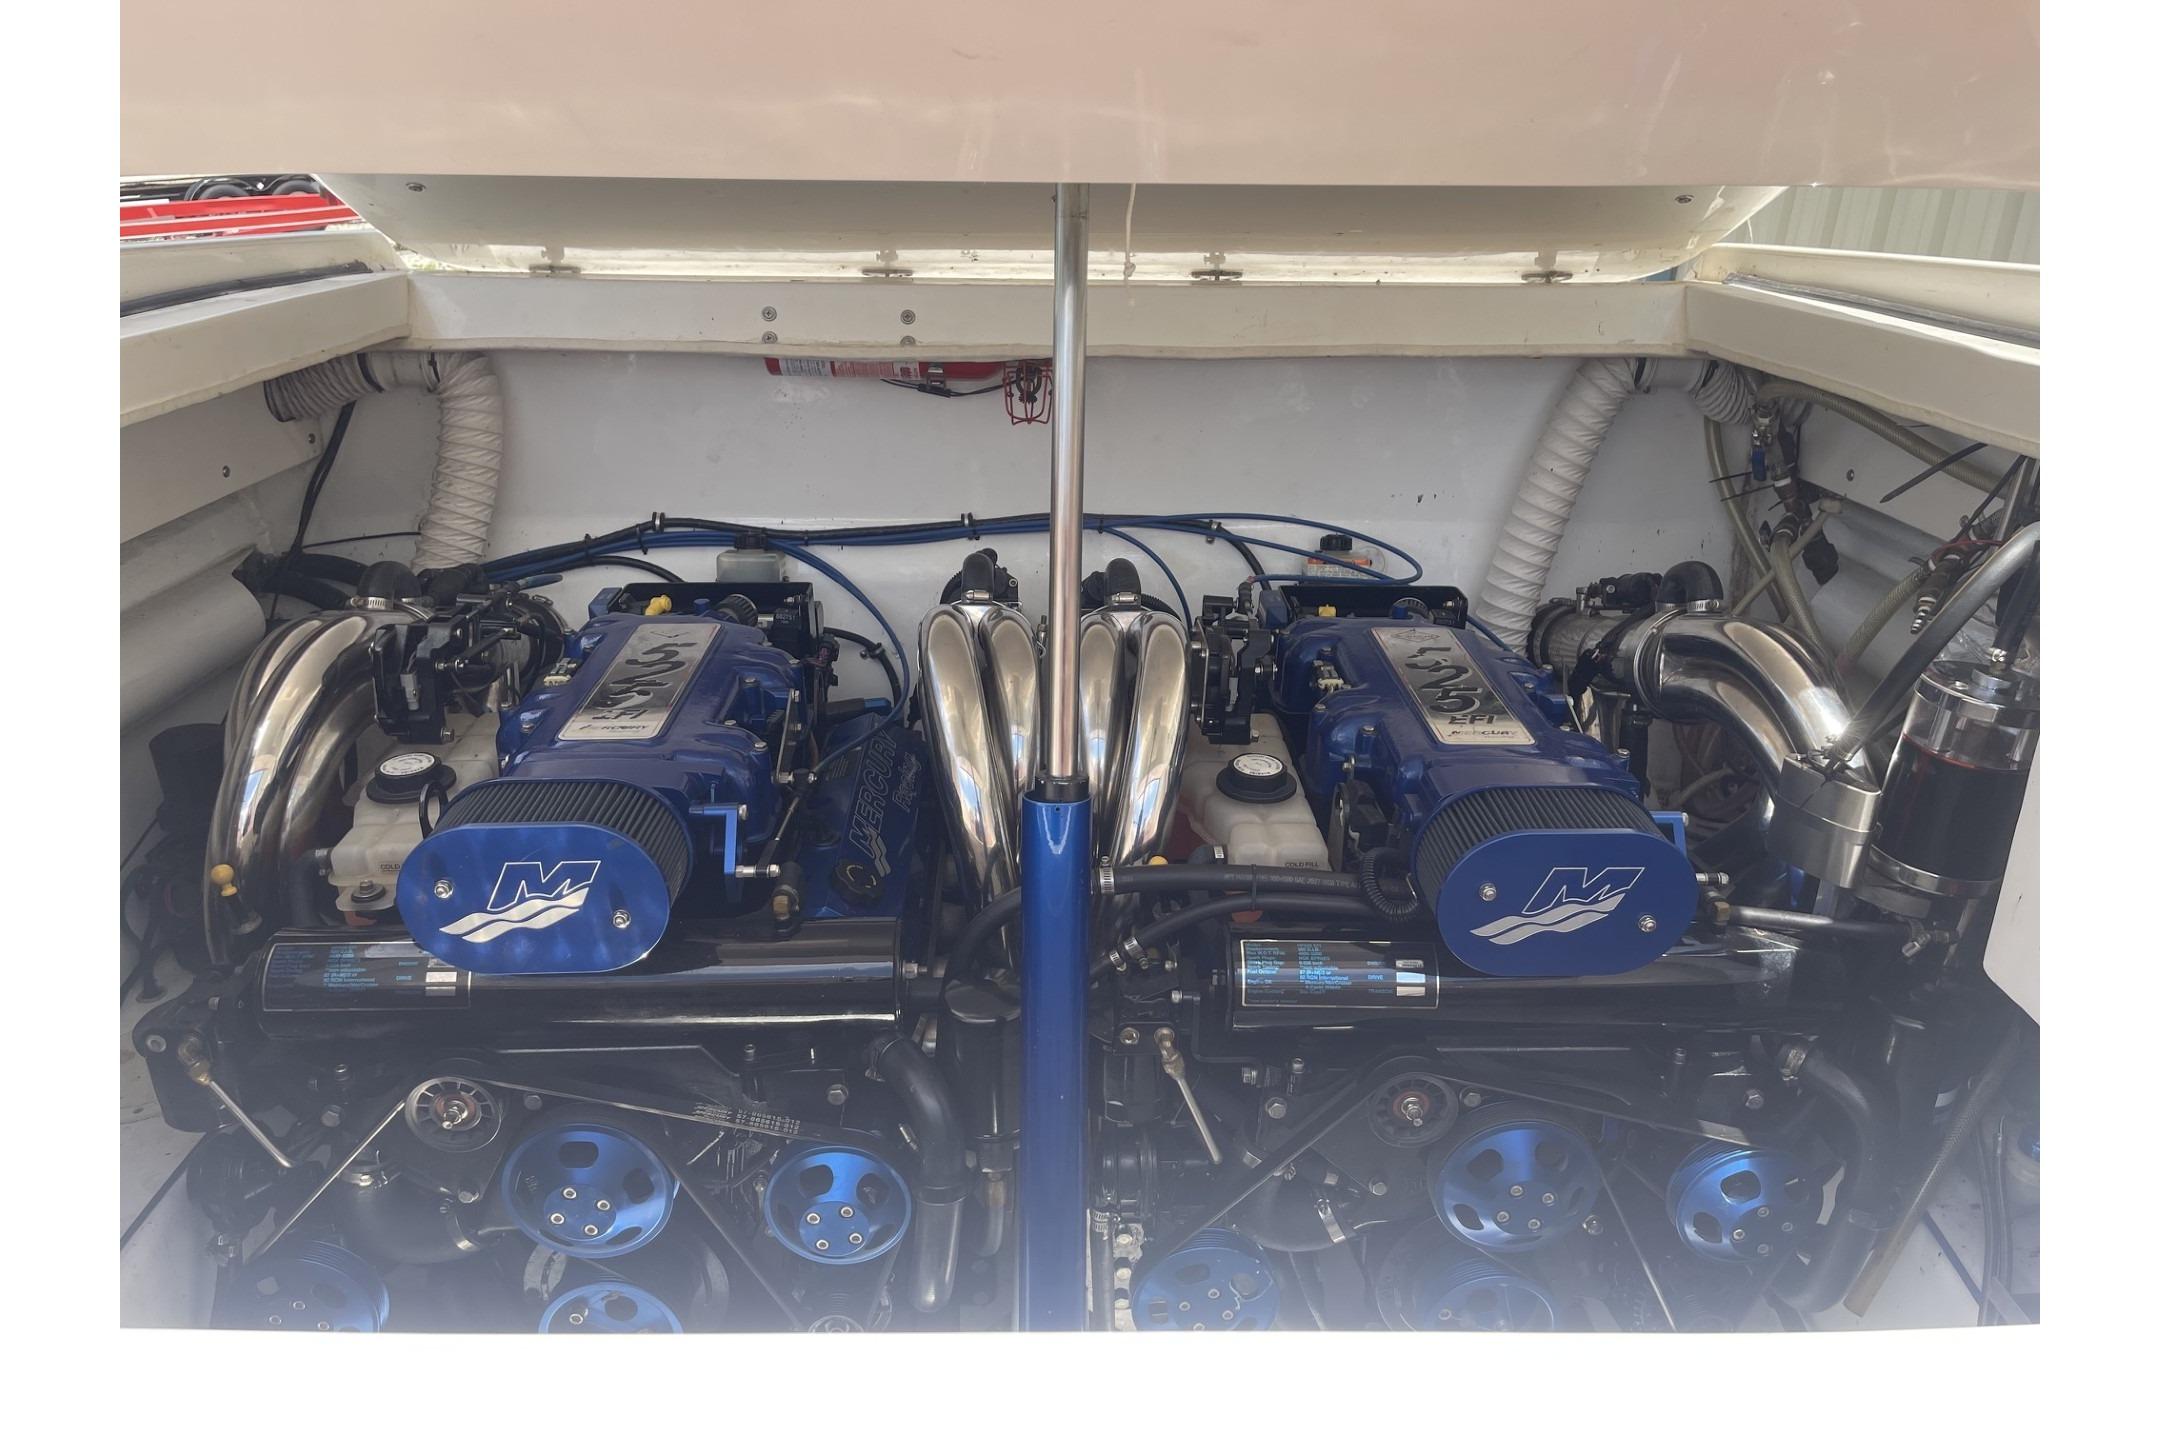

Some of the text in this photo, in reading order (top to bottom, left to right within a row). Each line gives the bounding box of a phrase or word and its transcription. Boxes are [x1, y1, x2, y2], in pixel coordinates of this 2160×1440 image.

[1405, 647, 1483, 714] 525
[1448, 714, 1496, 725] EFI
[849, 728, 898, 859] MERCURY
